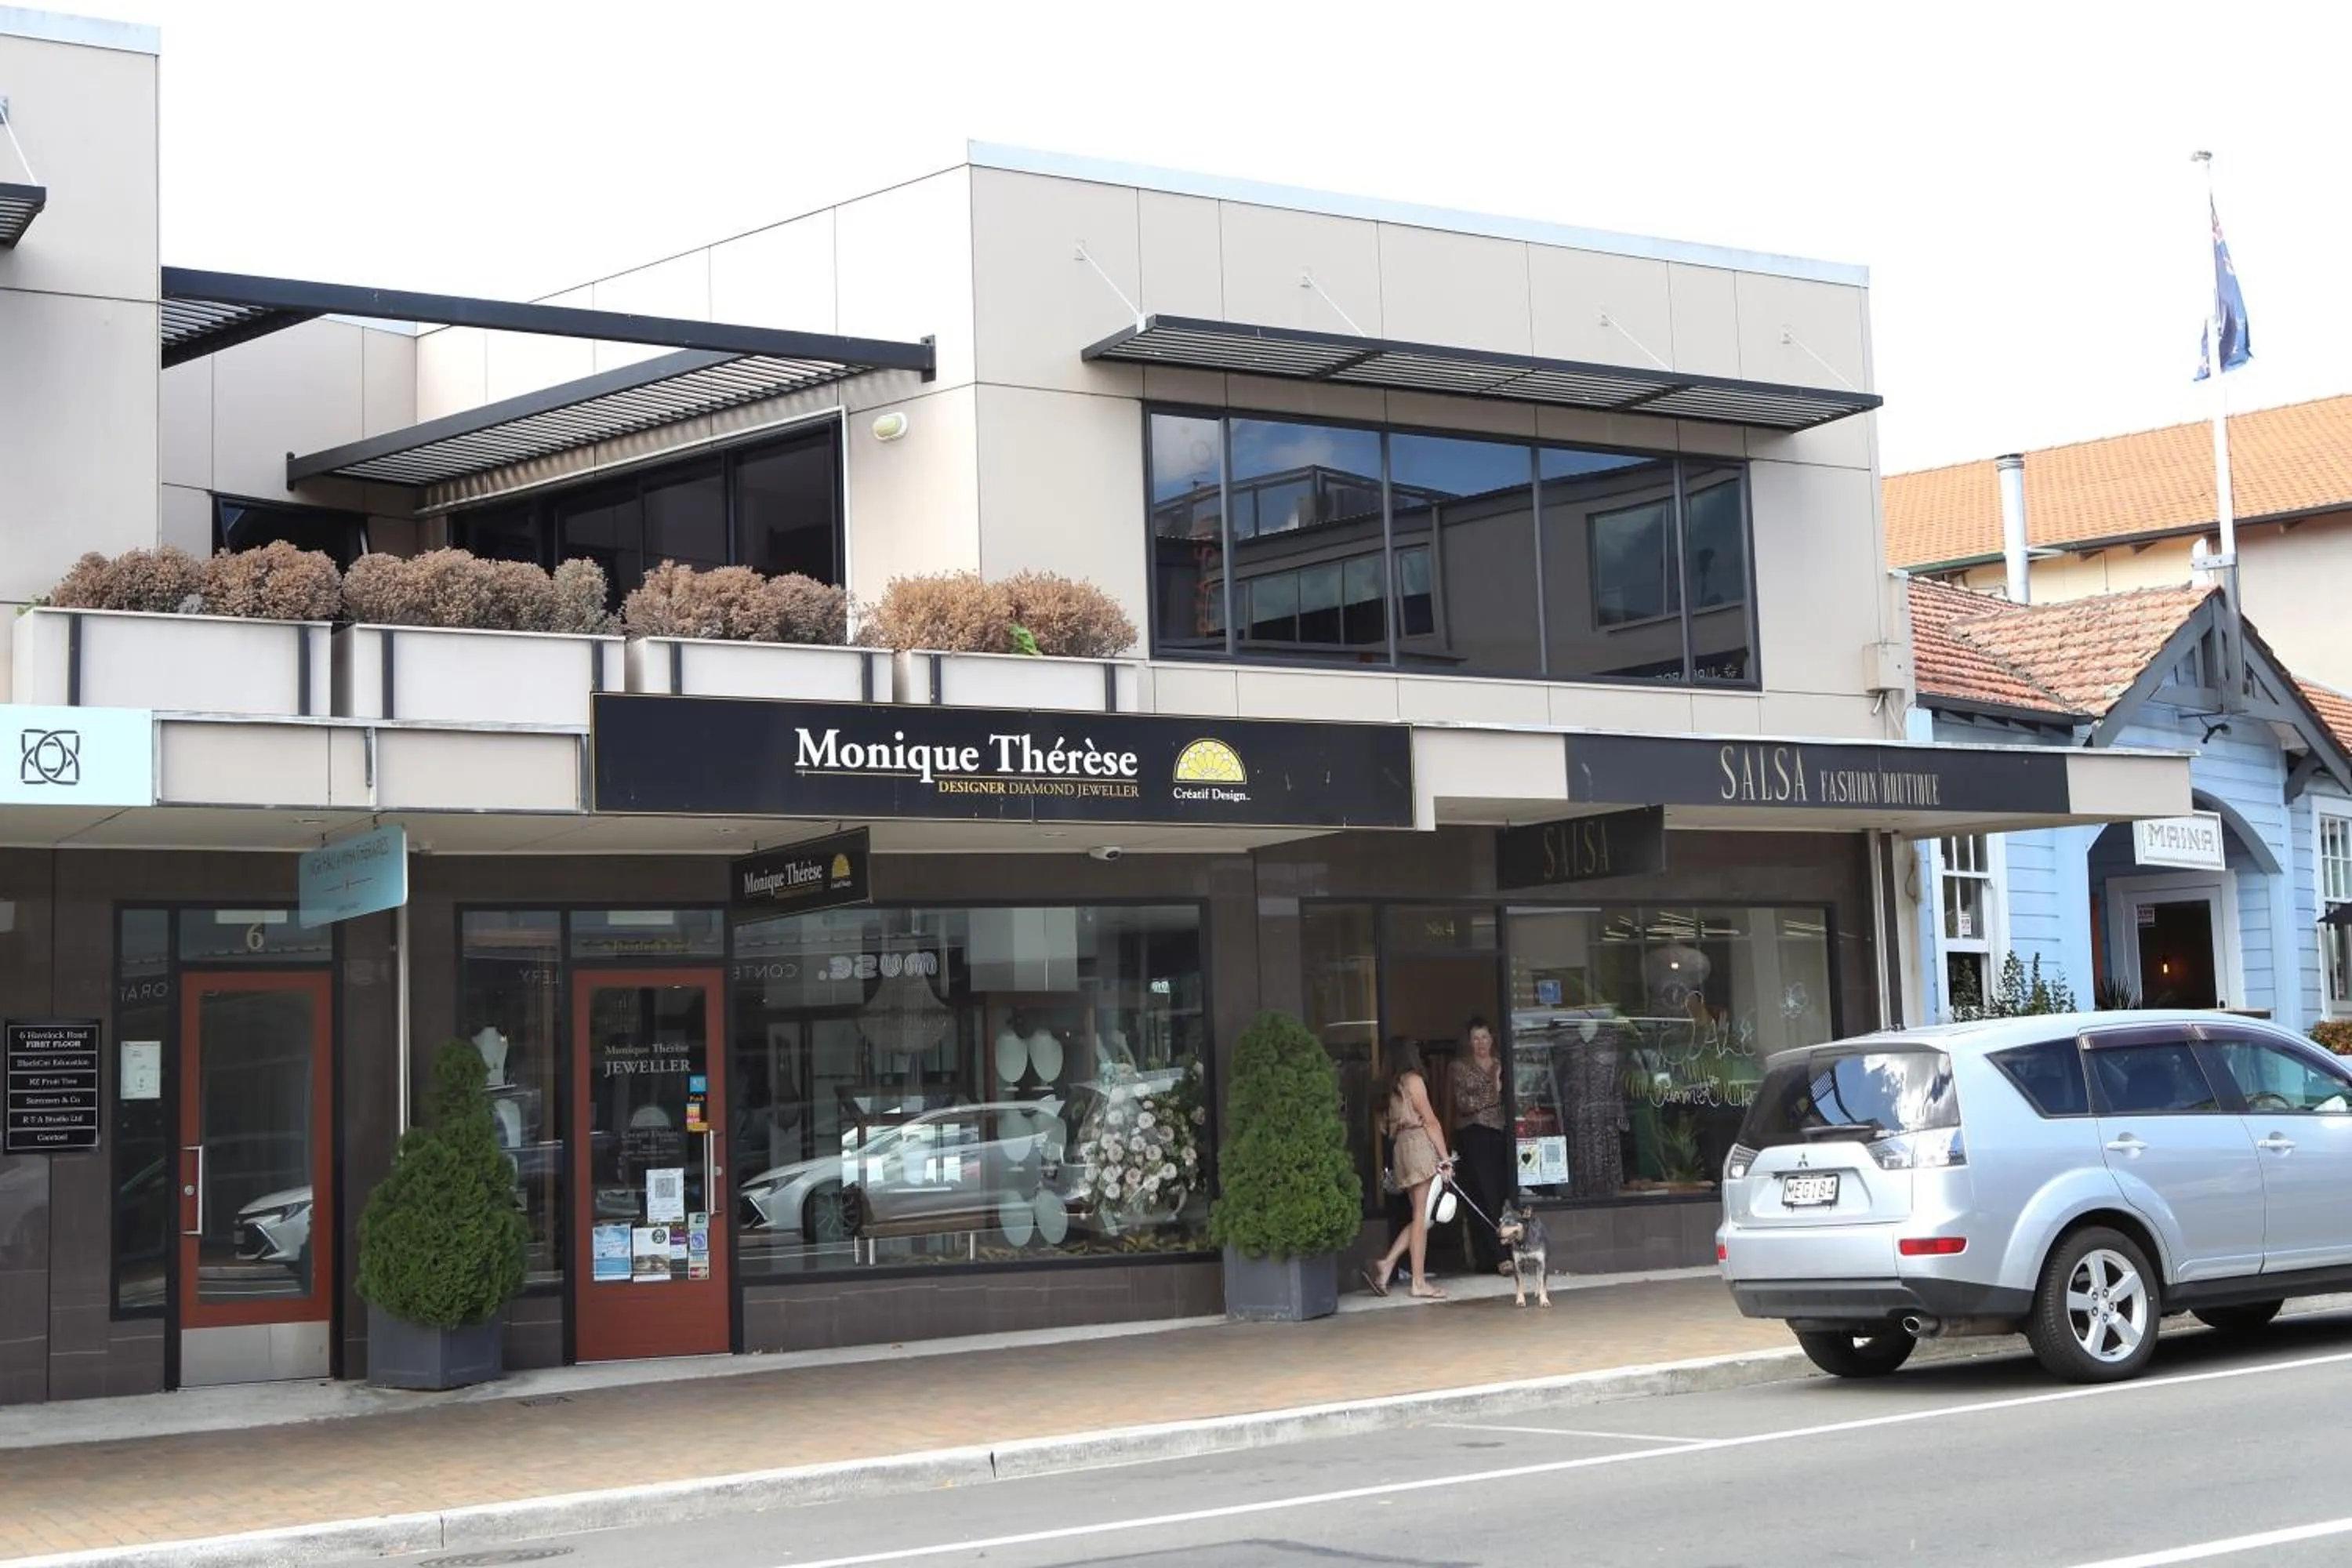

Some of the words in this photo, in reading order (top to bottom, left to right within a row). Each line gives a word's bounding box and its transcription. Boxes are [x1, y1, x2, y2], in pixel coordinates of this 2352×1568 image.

[793, 728, 980, 783] Monique
[989, 733, 1138, 776] Thérèse
[1720, 744, 1807, 802] SALSA
[1820, 769, 1878, 804] FASHION
[938, 779, 1006, 794] DESIGNER
[1009, 782, 1075, 796] DIAMOND
[1077, 783, 1140, 798] JEWELLER
[1173, 786, 1210, 800] Créatif
[2147, 823, 2216, 852] MAINA
[745, 869, 785, 896] Monique
[785, 858, 824, 886] Thérèse
[246, 922, 265, 950] 6
[604, 1044, 650, 1056] Monique
[604, 1059, 691, 1079] JEWELLER
